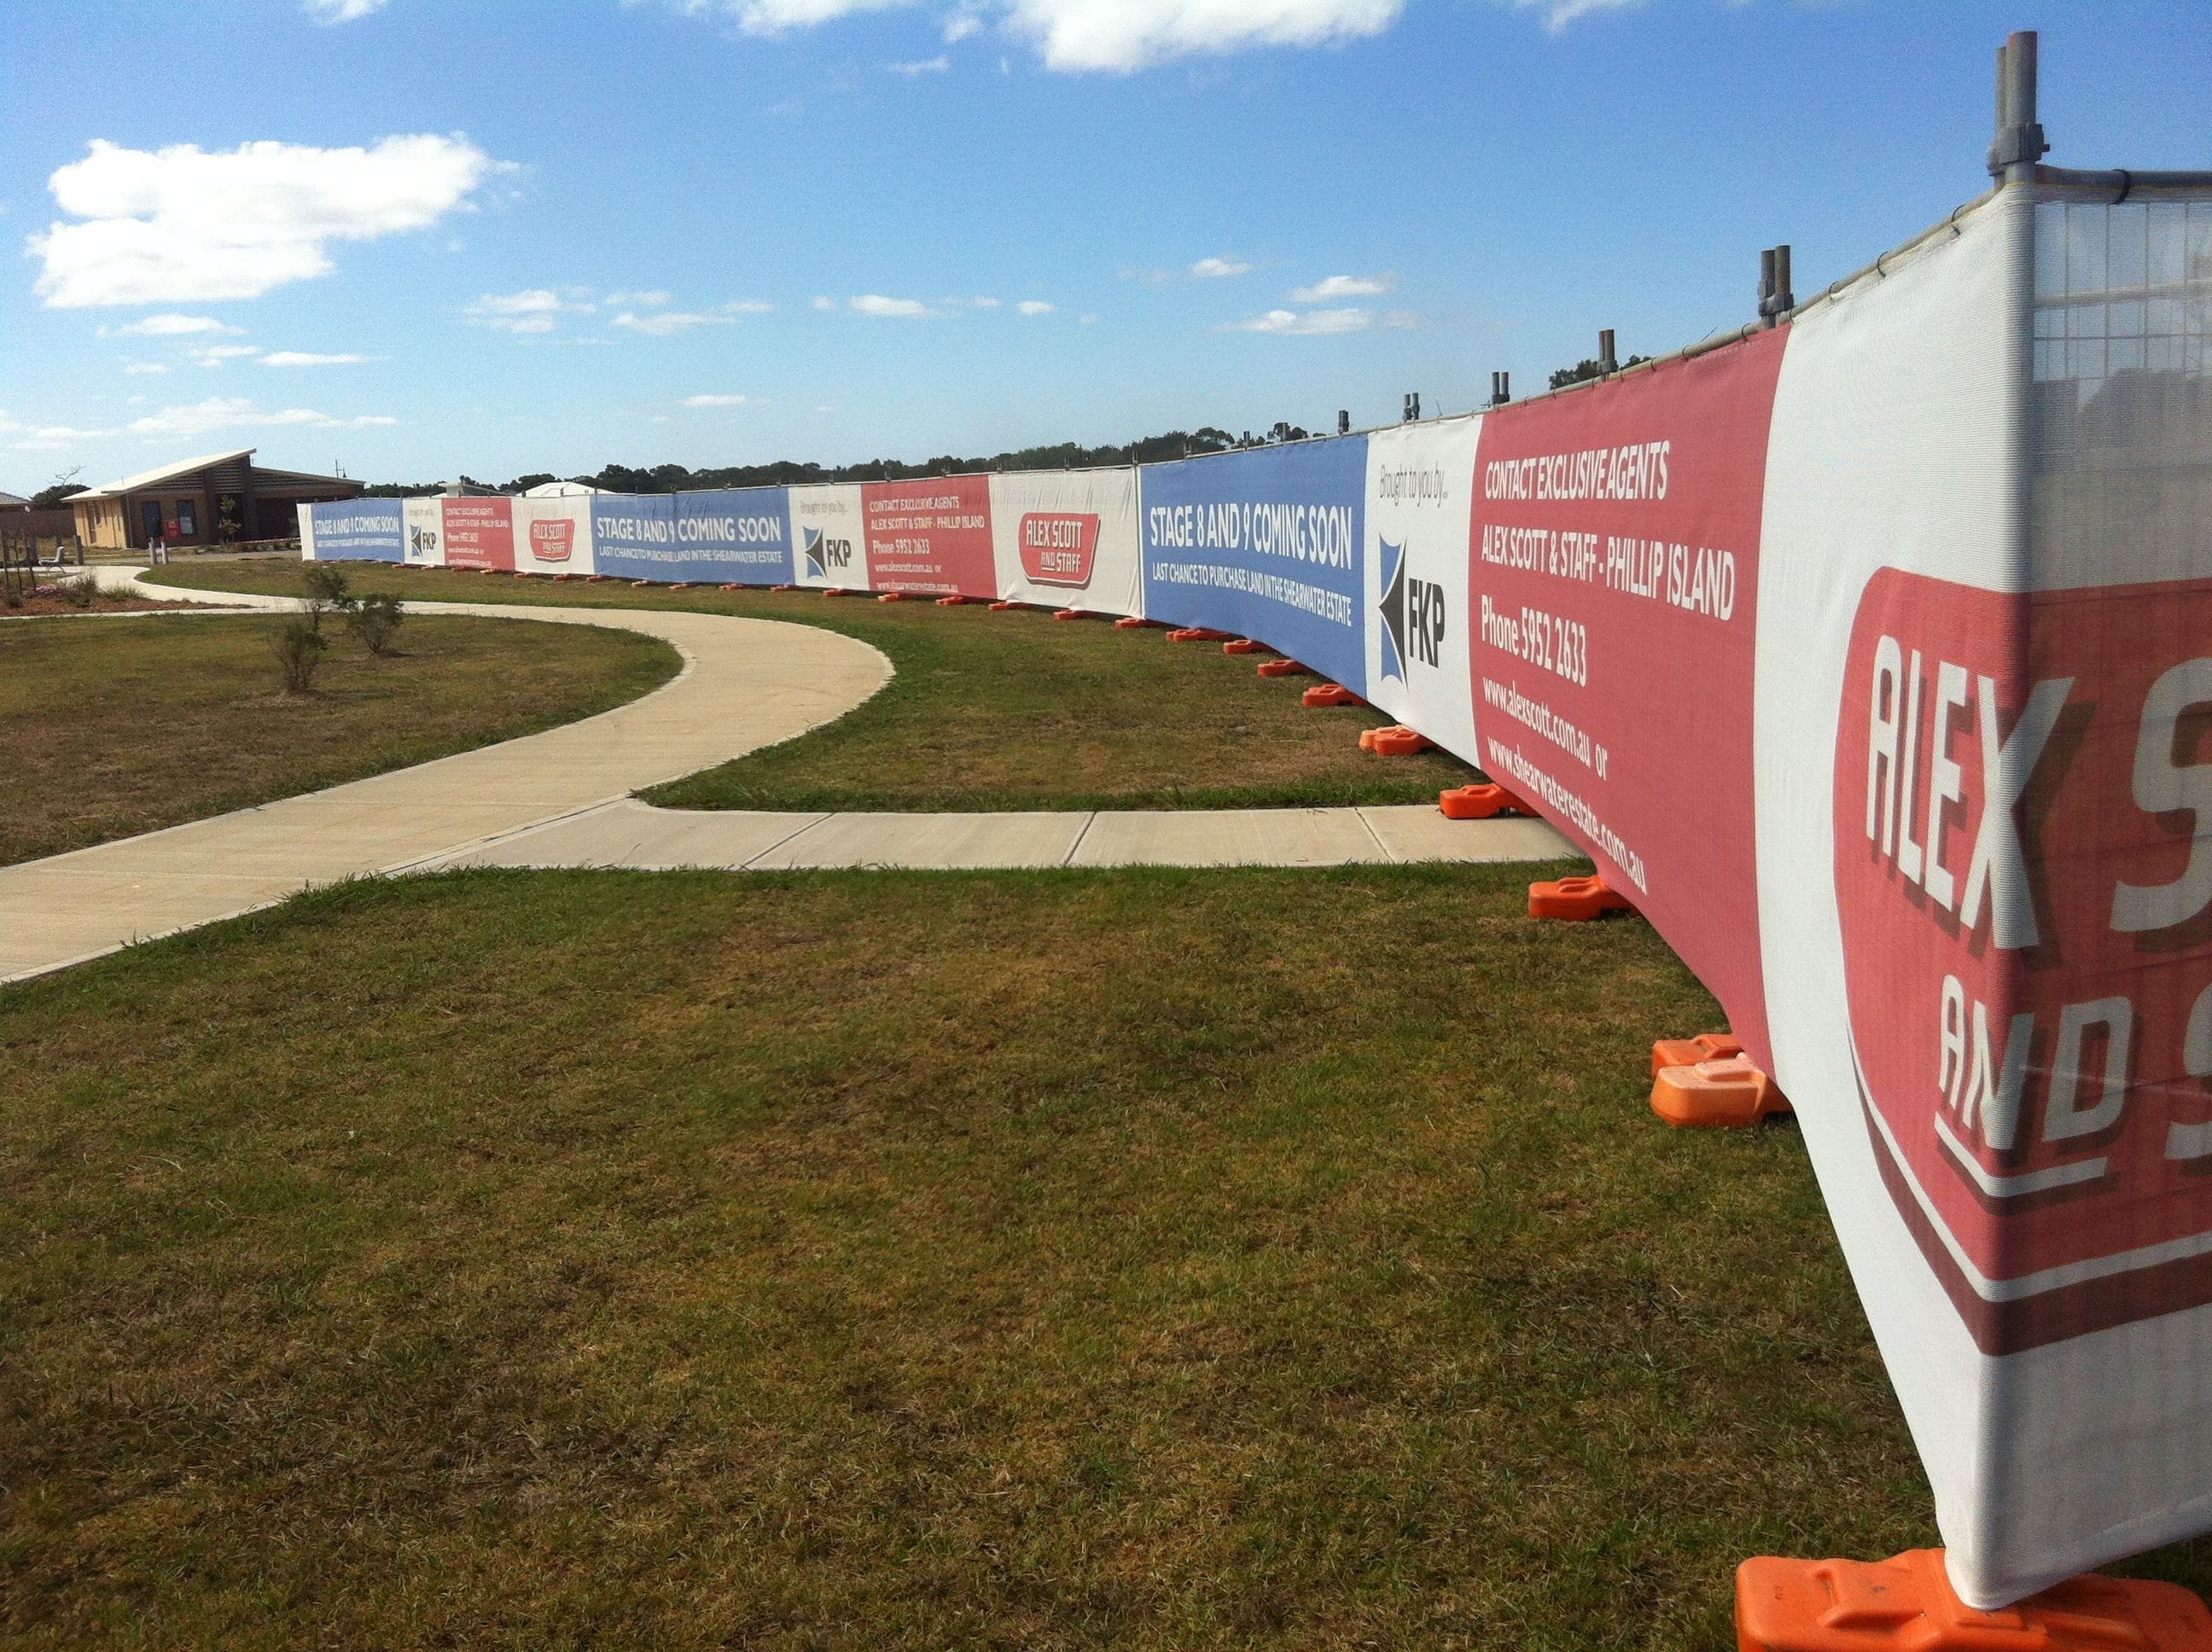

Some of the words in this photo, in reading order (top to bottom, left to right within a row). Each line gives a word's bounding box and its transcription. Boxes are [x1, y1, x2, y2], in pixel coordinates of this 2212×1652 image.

[1380, 463, 1406, 507] Brought
[1409, 465, 1417, 499] to
[1417, 470, 1434, 508] you
[1484, 457, 1537, 500] CONTACT
[1536, 447, 1607, 500] EXCLUSIVE
[1605, 439, 1670, 500] AGENTS
[422, 532, 436, 550] FKP
[597, 517, 635, 540] STAGE
[636, 519, 642, 541] 8
[643, 519, 667, 543] AND
[668, 520, 675, 543] 9
[678, 517, 735, 542] COMING
[738, 516, 781, 542] SOON
[758, 551, 783, 563] ESTATE
[826, 539, 851, 567] FKP
[1026, 519, 1051, 546] ALEX
[1052, 520, 1083, 549] SCOTT
[1041, 551, 1056, 567] AND
[1057, 552, 1081, 573] STAFF
[1150, 505, 1193, 547] STAGE
[1197, 504, 1204, 548] 8
[1207, 503, 1240, 549] AND
[1243, 502, 1250, 550] 9
[1253, 503, 1305, 561] COMING
[1308, 504, 1352, 570] SOON
[1152, 562, 1168, 581] LAST
[1169, 563, 1198, 585] CHANCE
[1198, 564, 1208, 585] TO
[1209, 565, 1247, 590] PURCHASE
[1247, 569, 1264, 596] LAND
[1264, 573, 1272, 598] IN
[1271, 575, 1284, 602] THE
[1284, 579, 1325, 618] SHEARWATER
[1326, 590, 1352, 627] ESTATE
[1481, 524, 1510, 566] ALEX
[1510, 526, 1547, 573] SCOTT
[1549, 530, 1558, 575] &
[1560, 531, 1598, 583] STAFF
[1606, 536, 1664, 599] PHILLIP
[1666, 542, 1735, 621] ISLAND
[1408, 577, 1445, 669] FKP
[1481, 594, 1518, 656] Phone
[1521, 606, 1552, 671] 5952
[1555, 616, 1587, 688] 2633
[1482, 677, 1591, 768] www.alexscott.com.au
[1595, 743, 1608, 781] or
[1487, 736, 1648, 896] www.shearwaterestate.com.au
[1866, 634, 2075, 950] ALEX
[1938, 974, 2133, 1149] AND
